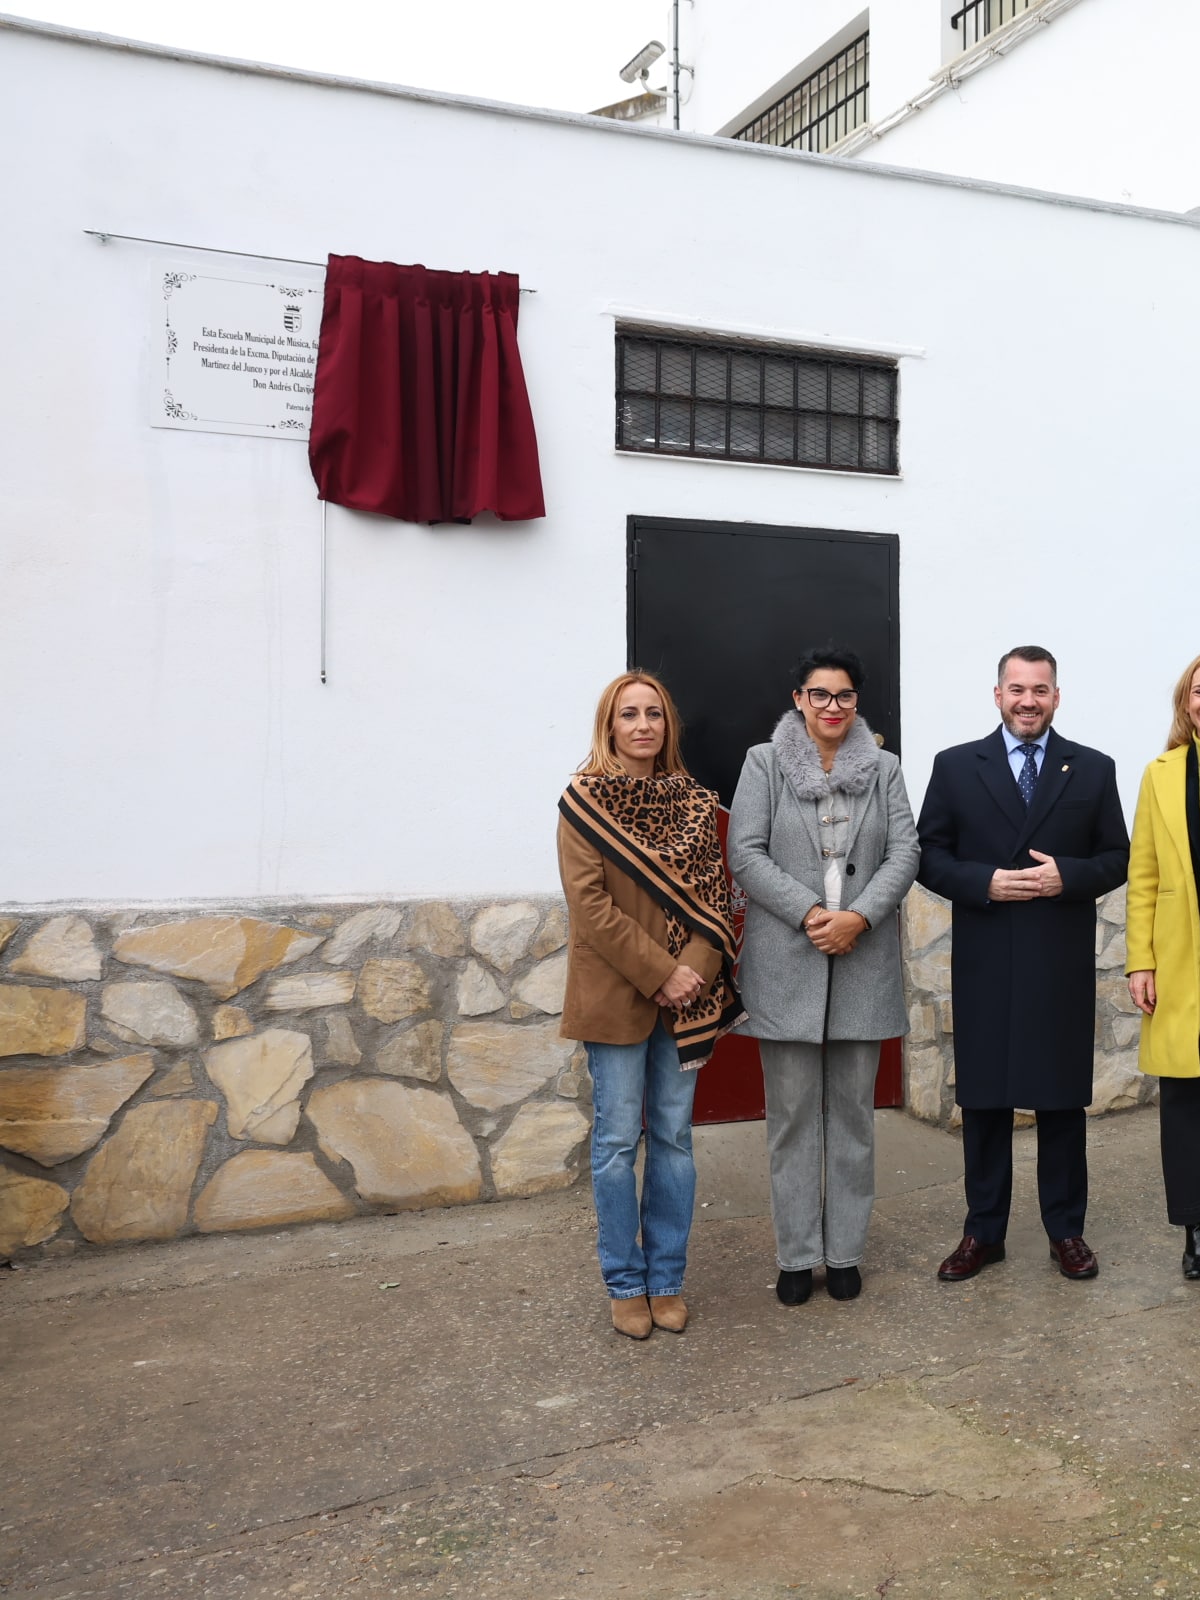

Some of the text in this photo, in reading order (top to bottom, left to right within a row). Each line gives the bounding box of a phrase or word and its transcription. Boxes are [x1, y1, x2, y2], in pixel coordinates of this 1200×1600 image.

[202, 327, 217, 338] Esta
[218, 329, 243, 341] Escuela
[244, 332, 276, 346] Municipal
[277, 336, 286, 346] de
[286, 337, 311, 349] Música,
[193, 341, 316, 364] Presidenta de la Excma. Diputación de
[231, 362, 242, 372] del
[243, 363, 263, 374] Junco
[263, 367, 268, 376] y
[269, 367, 281, 377] por
[282, 367, 289, 377] el
[289, 368, 313, 379] Alcalde
[252, 379, 267, 390] Don
[268, 380, 292, 392] Andrés
